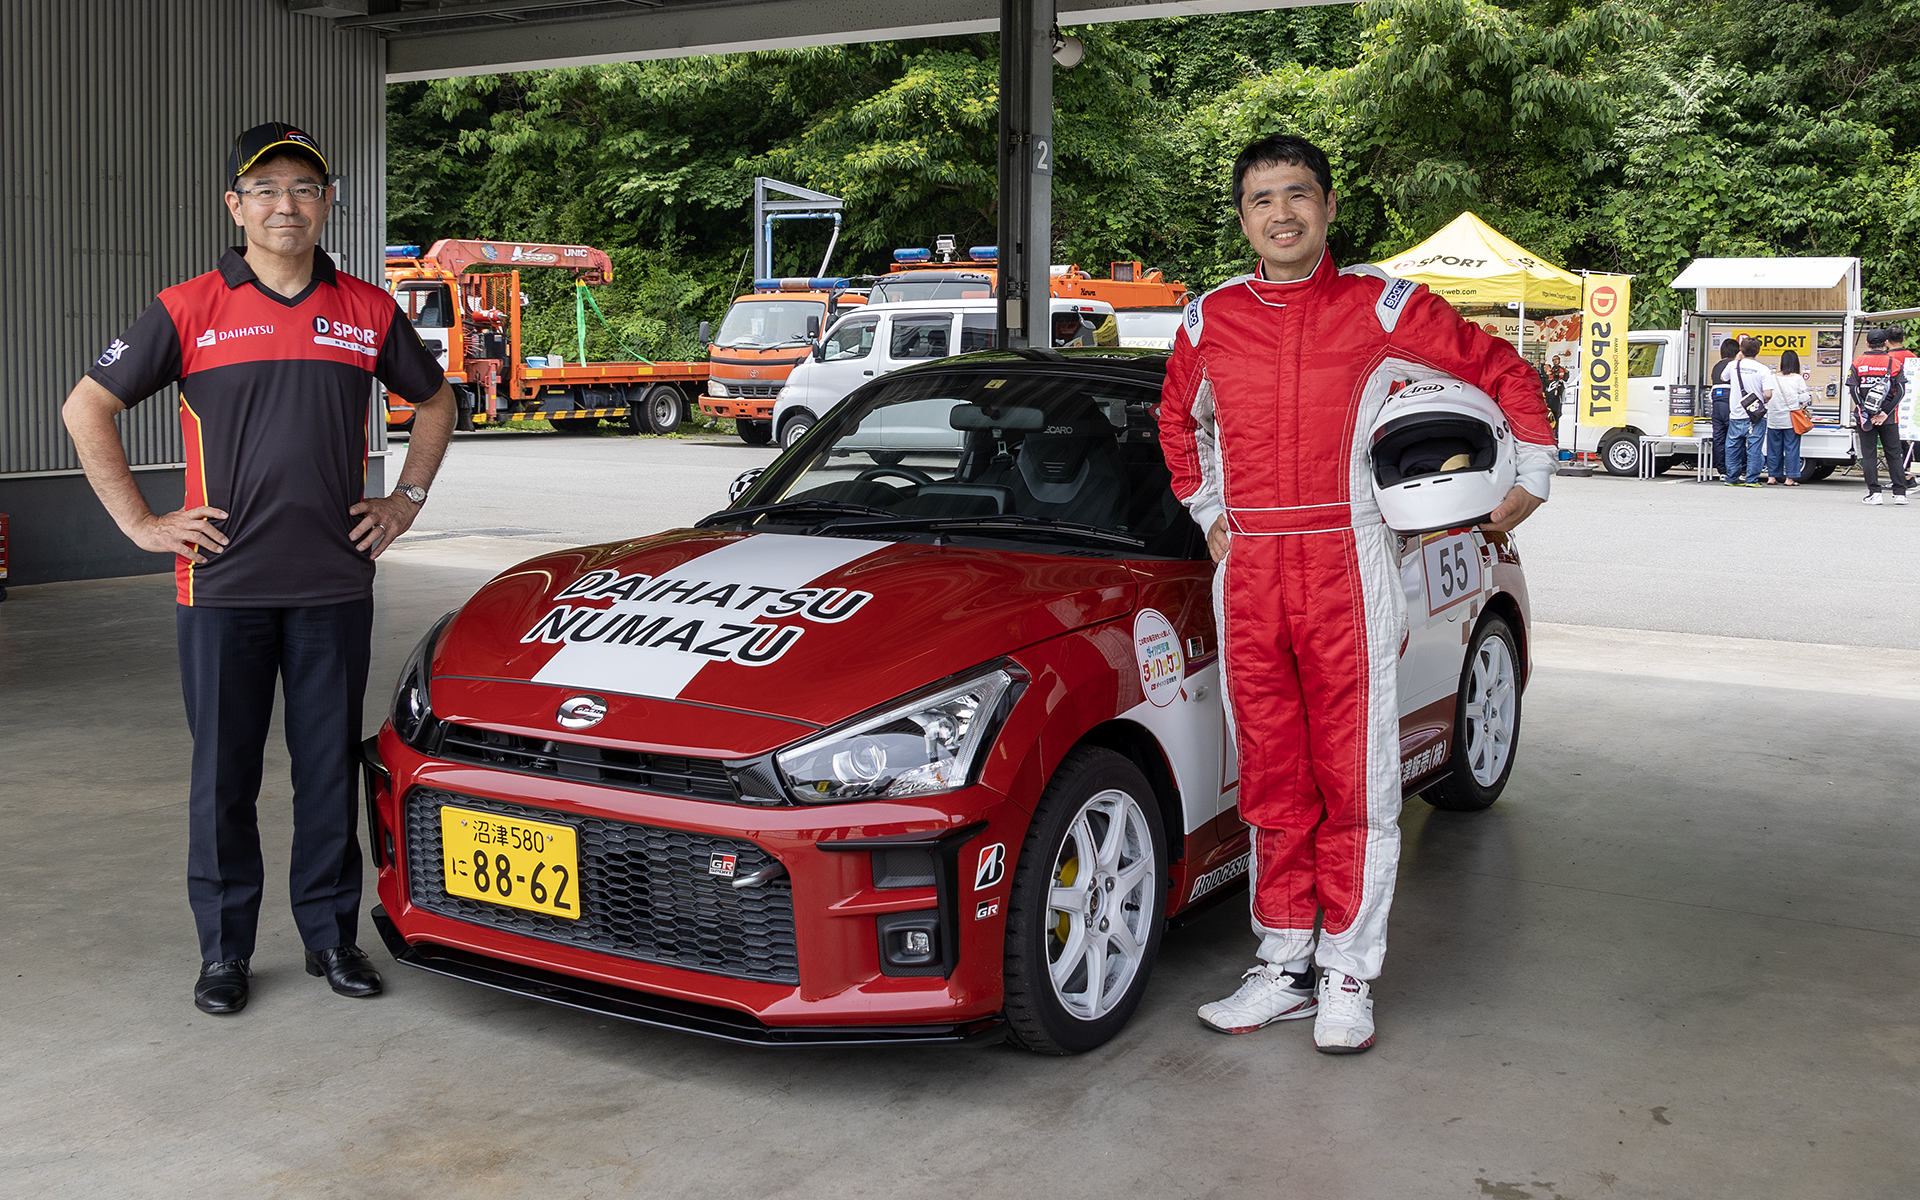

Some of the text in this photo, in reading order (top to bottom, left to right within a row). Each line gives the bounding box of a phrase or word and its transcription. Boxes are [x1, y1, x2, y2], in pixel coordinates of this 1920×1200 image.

[1037, 140, 1049, 170] 2
[332, 179, 341, 202] 1
[563, 248, 589, 258] UNIC
[1417, 254, 1488, 268] SPORT
[219, 325, 275, 341] DAIHATSU
[1439, 541, 1468, 598] 55
[555, 571, 873, 622] DAIHATSU
[523, 606, 803, 664] NUMAZU
[711, 859, 734, 871] GR
[1188, 851, 1252, 903] BRIDGESTO
[452, 850, 572, 911] に 88-62
[977, 904, 998, 919] GR
